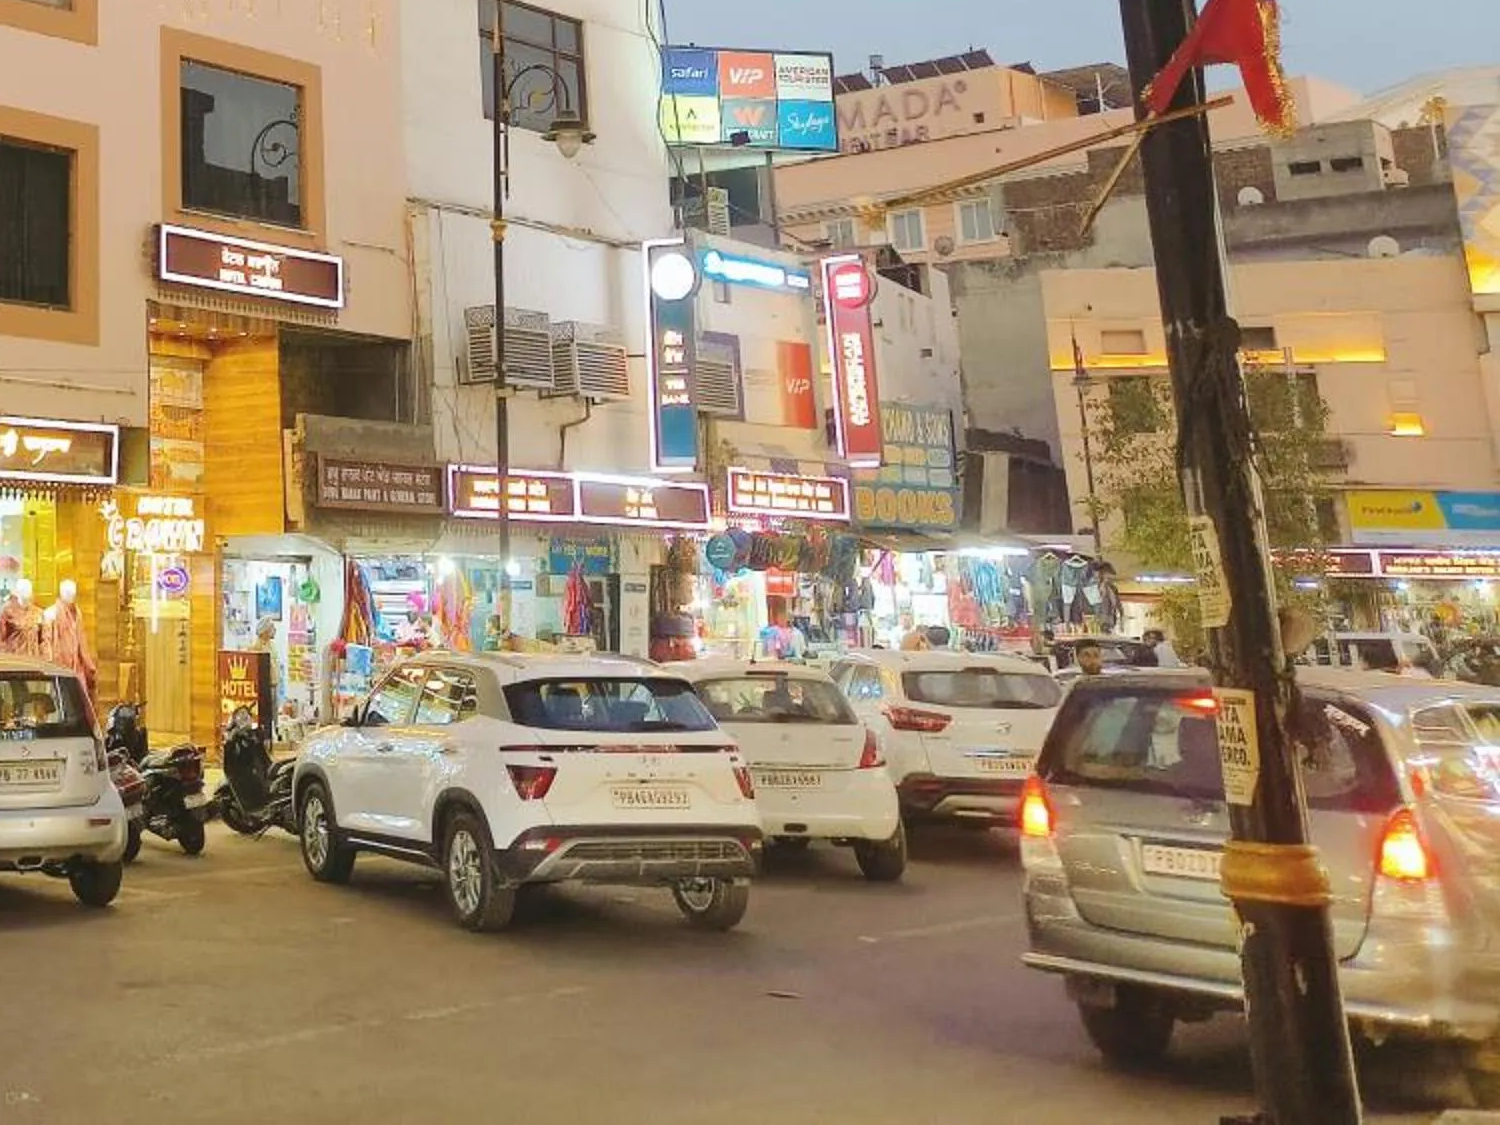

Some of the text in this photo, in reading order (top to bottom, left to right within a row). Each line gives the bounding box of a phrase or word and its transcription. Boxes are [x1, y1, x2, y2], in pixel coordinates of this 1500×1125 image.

[729, 67, 764, 85] VIP
[779, 65, 829, 76] AMERICAN
[786, 378, 811, 394] VIP
[220, 680, 259, 698] HOTEL
